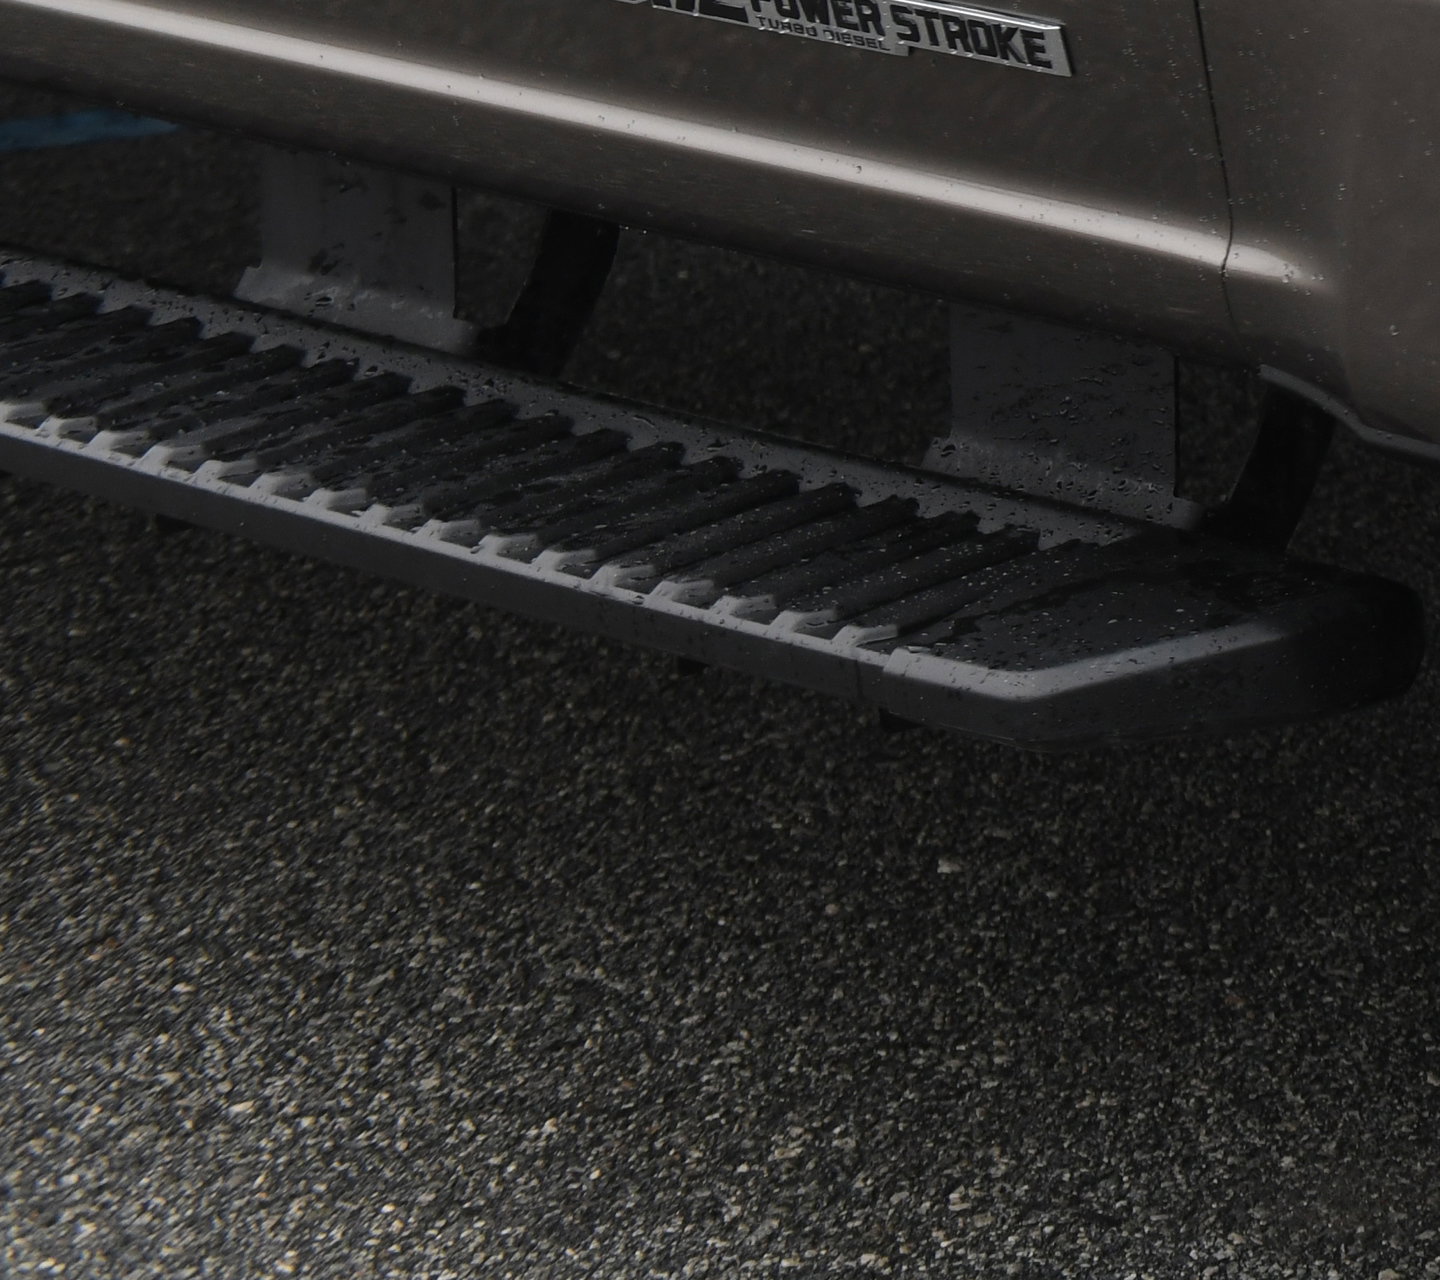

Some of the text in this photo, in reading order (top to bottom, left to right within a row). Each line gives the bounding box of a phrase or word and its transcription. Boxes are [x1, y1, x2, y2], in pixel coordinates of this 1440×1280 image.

[756, 15, 892, 53] TURBO DIESEL
[890, 3, 1054, 70] STROKE
